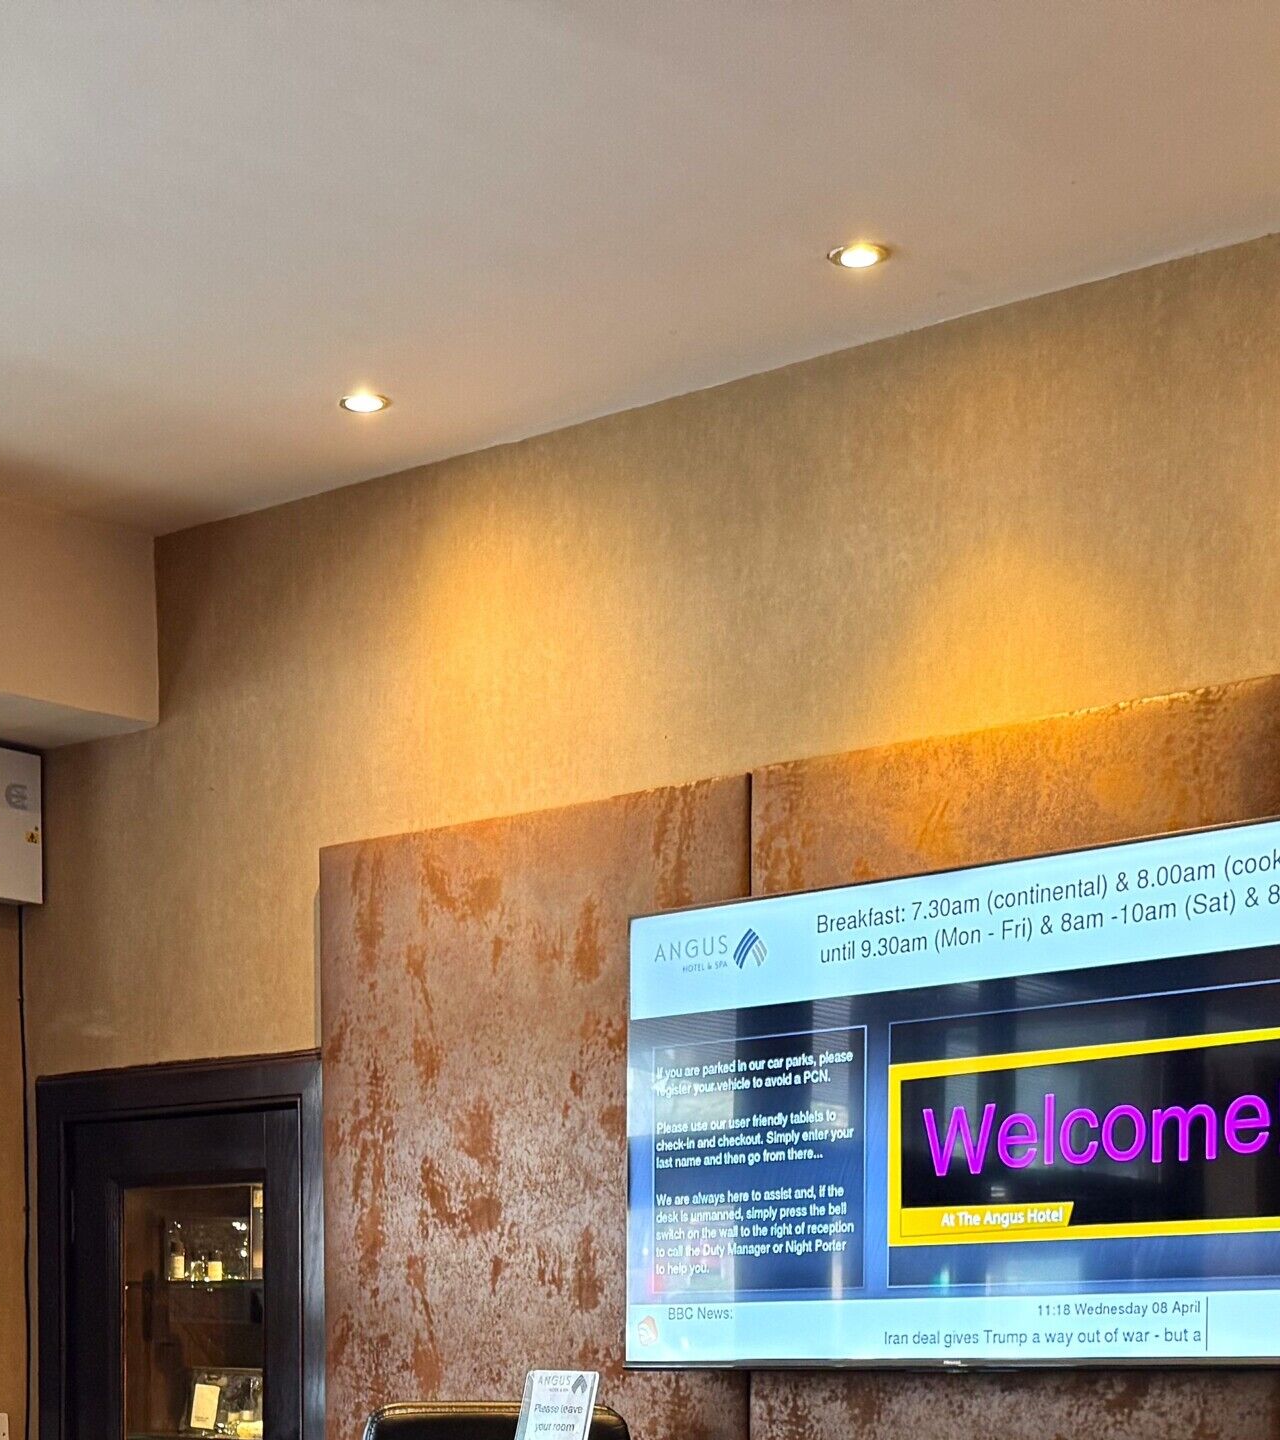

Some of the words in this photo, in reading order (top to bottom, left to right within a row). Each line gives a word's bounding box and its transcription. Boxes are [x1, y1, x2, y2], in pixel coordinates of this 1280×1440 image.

[817, 908, 905, 933] Breakfast:
[912, 898, 979, 921] 7.30am
[987, 875, 1107, 915] (continental)
[1116, 872, 1128, 892] &
[1137, 863, 1215, 889] 8.00am
[821, 941, 855, 963] until
[861, 936, 927, 958] 9.30am
[935, 927, 980, 954] (Mon
[1002, 917, 1033, 942] Fri)
[1041, 916, 1053, 934] &
[1061, 910, 1103, 932] 8am
[1185, 890, 1235, 921] (Sat)
[1245, 887, 1259, 907] &
[654, 934, 728, 962] ANGUS
[683, 963, 705, 973] HOTEL
[715, 960, 727, 969] SPA
[664, 1068, 682, 1082] you
[685, 1067, 699, 1076] are
[702, 1060, 735, 1080] parked
[738, 1060, 746, 1071] in
[749, 1061, 765, 1070] our
[768, 1059, 783, 1069] car
[786, 1054, 816, 1070] parks,
[819, 1050, 853, 1068] please
[717, 1077, 750, 1091] vehicle
[753, 1076, 763, 1088] to
[765, 1073, 792, 1087] avoid
[795, 1075, 800, 1084] a
[804, 1070, 830, 1084] PCN.
[656, 1122, 688, 1134] Please
[691, 1121, 707, 1131] use
[710, 1121, 726, 1130] our
[729, 1119, 750, 1129] user
[753, 1112, 788, 1128] friendly
[790, 1110, 823, 1124] tablets
[827, 1111, 836, 1121] to
[656, 1137, 694, 1151] check-in
[697, 1136, 715, 1148] and
[718, 1133, 763, 1147] checkout.
[766, 1130, 799, 1145] Simply
[802, 1129, 828, 1141] enter
[830, 1128, 854, 1142] your
[656, 1156, 672, 1169] last
[675, 1156, 701, 1167] name
[704, 1153, 722, 1166] and
[724, 1152, 745, 1165] then
[748, 1153, 760, 1165] go
[763, 1149, 785, 1162] from
[787, 1148, 823, 1160] there...
[656, 1194, 672, 1206] We
[675, 1195, 689, 1205] are
[692, 1192, 725, 1207] always
[728, 1190, 749, 1203] here
[752, 1191, 761, 1201] to
[764, 1187, 791, 1200] assist
[795, 1186, 816, 1200] and,
[819, 1185, 825, 1197] if
[827, 1184, 844, 1196] the
[656, 1211, 678, 1223] desk
[681, 1211, 688, 1222] is
[690, 1208, 744, 1223] unmanned,
[746, 1206, 777, 1221] simply
[780, 1205, 807, 1219] press
[810, 1203, 825, 1215] the
[828, 1202, 847, 1215] bell
[941, 1213, 955, 1226] At
[958, 1212, 981, 1226] The
[984, 1210, 1025, 1229] Angus
[1027, 1207, 1063, 1223] Hotel
[656, 1227, 685, 1240] switch
[688, 1230, 699, 1239] on
[702, 1226, 716, 1238] the
[719, 1225, 738, 1237] wall
[741, 1225, 750, 1237] to
[752, 1223, 768, 1236] the
[771, 1222, 792, 1237] right
[795, 1223, 805, 1235] of
[807, 1220, 854, 1235] reception
[656, 1246, 665, 1258] to
[668, 1244, 683, 1257] call
[685, 1244, 700, 1256] the
[703, 1243, 724, 1258] Duty
[728, 1242, 769, 1258] Manager
[772, 1242, 783, 1253] or
[786, 1240, 812, 1255] Night
[815, 1238, 846, 1252] Porter
[656, 1263, 665, 1275] to
[668, 1263, 686, 1276] help
[668, 1307, 693, 1320] BBC
[697, 1307, 733, 1319] News:
[1038, 1304, 1070, 1316] 11:18
[1075, 1302, 1147, 1317] Wednesday
[1152, 1302, 1168, 1314] 08
[1172, 1301, 1201, 1316] April
[884, 1331, 908, 1345] Iran
[913, 1331, 940, 1345] deal
[944, 1332, 978, 1348] gives
[984, 1330, 1028, 1346] Trump
[1032, 1333, 1040, 1344] a
[1044, 1333, 1072, 1347] way
[1078, 1330, 1101, 1344] out
[1105, 1328, 1118, 1343] of
[1122, 1332, 1149, 1343] war
[1165, 1328, 1189, 1343] but
[1193, 1331, 1201, 1342] a
[538, 1375, 572, 1385] ANGUS
[534, 1404, 559, 1413] Please
[561, 1405, 583, 1414] leave
[535, 1424, 551, 1432] your
